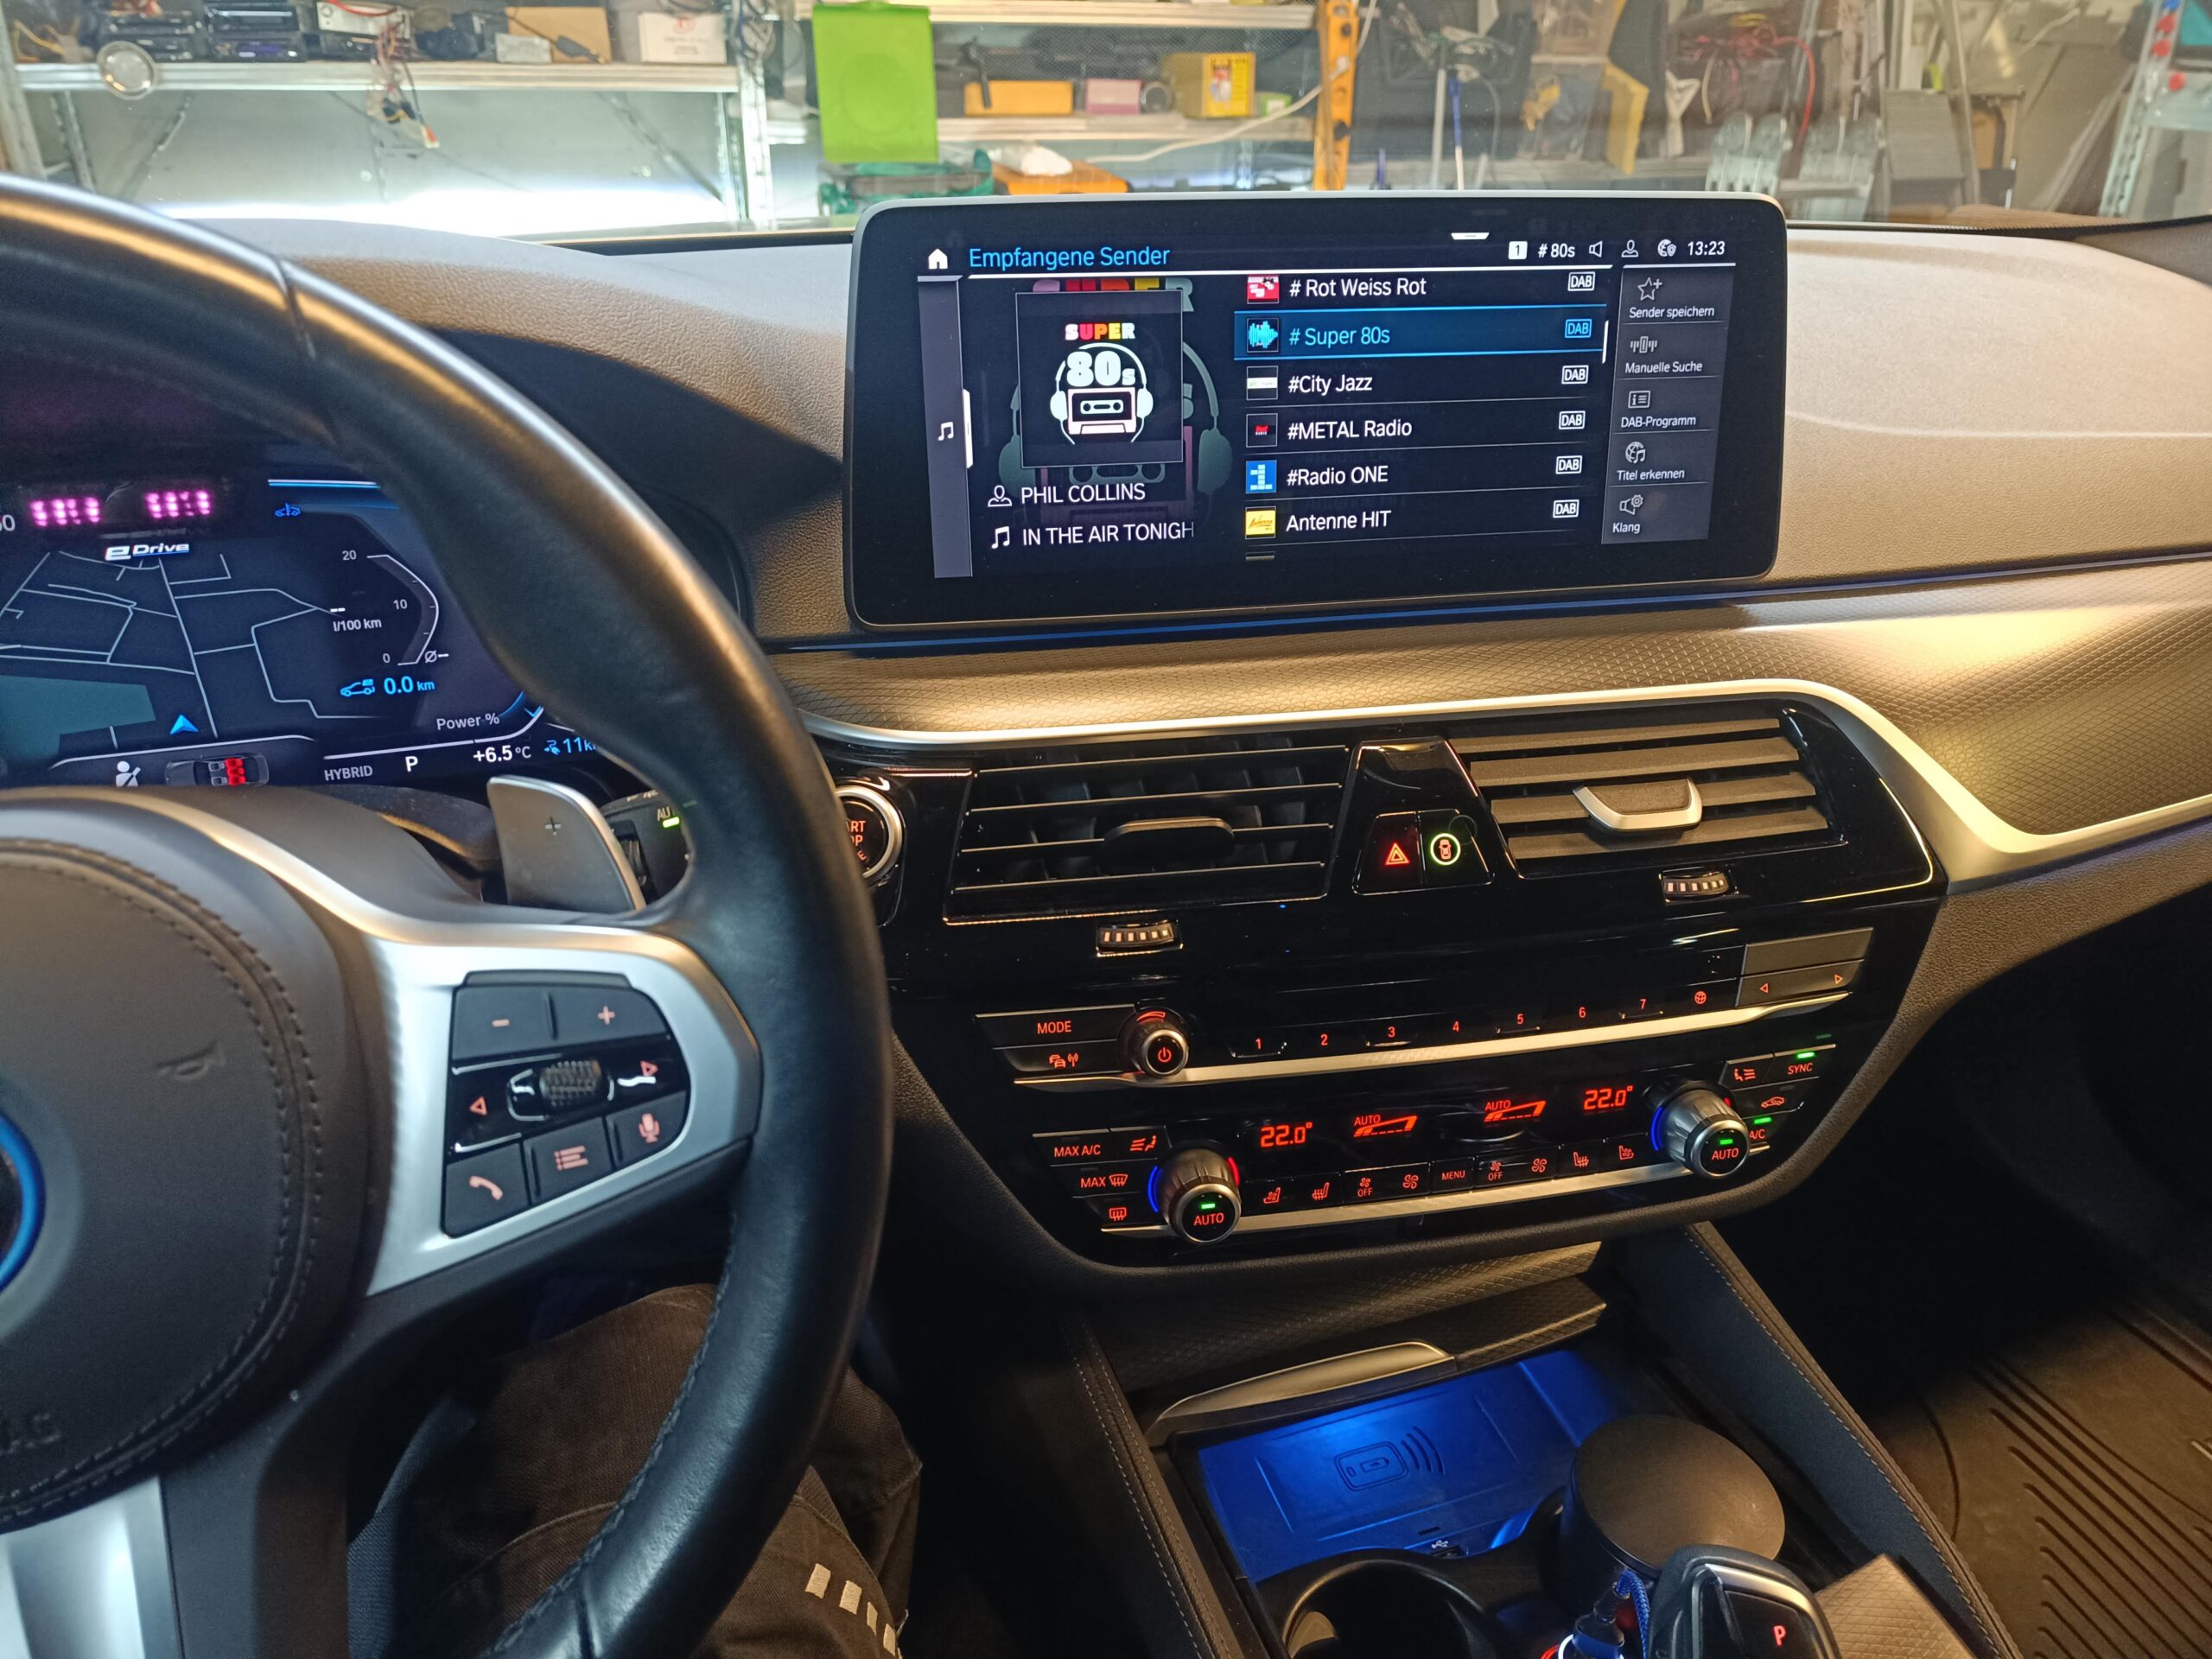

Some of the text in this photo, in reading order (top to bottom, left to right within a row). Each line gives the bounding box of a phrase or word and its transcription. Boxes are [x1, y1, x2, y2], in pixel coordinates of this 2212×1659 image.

[1551, 243, 1575, 257] 80s
[1688, 241, 1726, 256] 13:23
[969, 245, 1171, 271] Empfangene Sender
[1289, 276, 1427, 297] # Rot Weiss Rot
[1570, 276, 1592, 289] DAB
[1630, 306, 1714, 320] Sender speichern
[1065, 322, 1135, 340] SUPER
[1567, 323, 1589, 335] DAB
[1289, 326, 1390, 348] # Super 80s
[1066, 350, 1135, 387] 80s
[1625, 360, 1702, 374] Manuelle Suche
[1564, 369, 1586, 381] DAB
[1288, 373, 1372, 395] #City Jazz
[1560, 415, 1582, 427] DAB
[1621, 416, 1696, 429] DAB-Programm
[1287, 418, 1413, 441] #METAL Radio
[1558, 459, 1580, 472] DAB
[1287, 465, 1389, 486] #Radio ONE
[1618, 469, 1685, 481] Titel erkennen
[1021, 483, 1146, 505] PHIL COLLINS
[1555, 503, 1577, 515] DAB
[0, 514, 16, 531] 0
[1286, 510, 1392, 532] Antenne HIT
[1023, 529, 1040, 546] IN
[1046, 526, 1084, 544] THE
[1088, 524, 1119, 543] AIR
[1612, 522, 1641, 535] Klang
[342, 550, 357, 562] 20
[393, 599, 408, 610] 10
[364, 618, 382, 630] km
[383, 652, 391, 664] 0
[384, 676, 435, 695] 0.0 km
[436, 713, 499, 731] Power %
[563, 737, 596, 754] 11k
[405, 755, 418, 772] P
[324, 765, 373, 781] HYBRID
[1640, 999, 1647, 1009] 7
[1516, 1014, 1523, 1025] 5
[1579, 1007, 1586, 1019] 6
[1037, 1020, 1071, 1034] MODE
[1388, 1027, 1395, 1038] 3
[1452, 1021, 1459, 1033] 4
[1255, 1038, 1262, 1049] 1
[1321, 1034, 1328, 1046] 2
[1788, 1062, 1813, 1075] SYNC
[1484, 1099, 1511, 1112] AUTO
[1354, 1114, 1381, 1127] AUTO
[1054, 1144, 1102, 1158] MAX A/C
[1712, 1147, 1739, 1160] AUTO
[1441, 1170, 1465, 1181] MENU
[1488, 1171, 1503, 1181] OFF
[1081, 1177, 1106, 1188] MAX
[1357, 1187, 1373, 1198] OFF
[1193, 1212, 1224, 1227] AUTO
[1773, 1625, 1786, 1646] P
